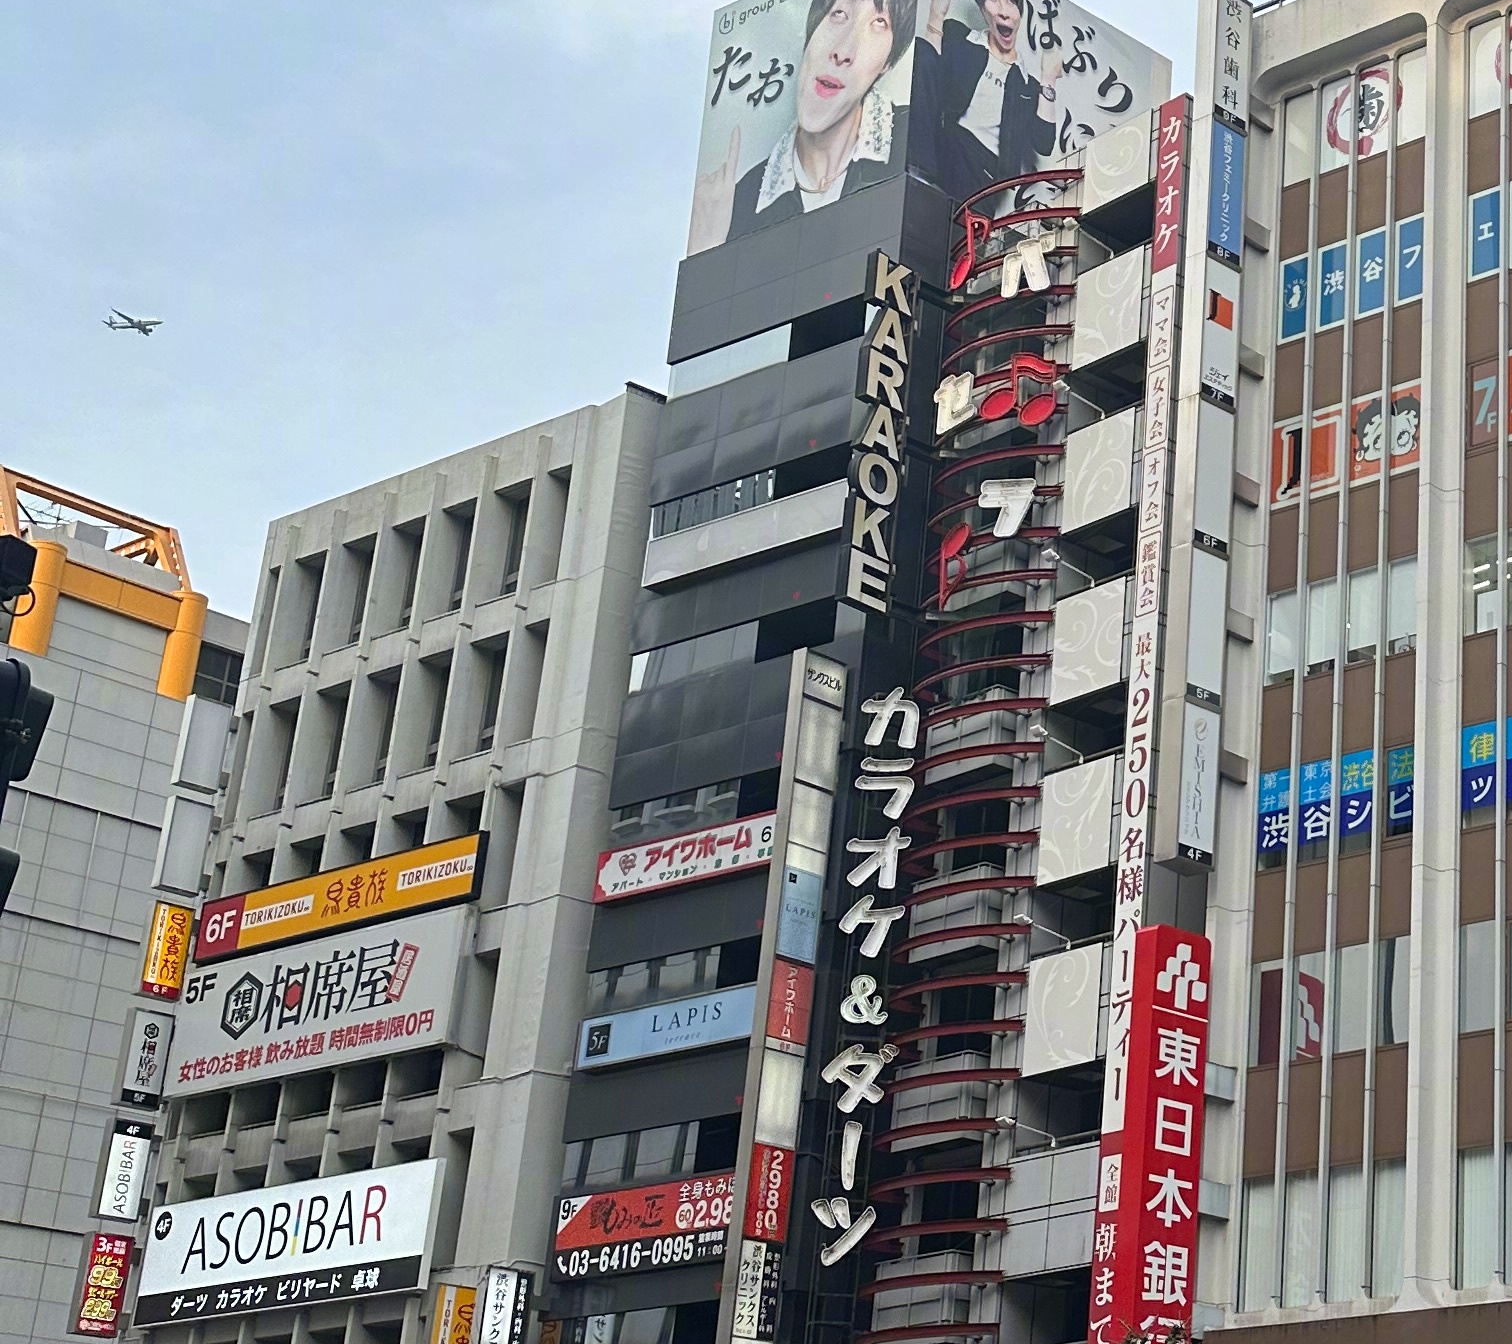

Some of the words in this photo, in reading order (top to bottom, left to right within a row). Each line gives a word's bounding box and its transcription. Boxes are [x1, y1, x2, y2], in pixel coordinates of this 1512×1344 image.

[1154, 117, 1183, 255] カラオケ
[1152, 295, 1171, 358] ママ会
[841, 250, 913, 614] KARAOKE
[1148, 375, 1167, 441] 女子会
[1144, 457, 1162, 524] オフ会
[643, 825, 753, 873] アイワホーム
[1110, 632, 1153, 1103] 最大250名様パーティー
[1187, 847, 1203, 861] 4F
[320, 867, 389, 919] 鳥貴族
[400, 864, 468, 887] TORIKIZOKU
[204, 909, 238, 944] 6F
[244, 899, 303, 926] TORIKIZOKU
[152, 985, 169, 995] 6F
[186, 972, 218, 1005] 5F
[260, 938, 400, 1034] 相席屋
[810, 685, 921, 1268] カラオケ&ダーツ
[178, 1045, 263, 1084] 女性のお客様
[265, 1032, 326, 1065] 飲み放題
[328, 1008, 435, 1051] 時間無制限0円
[588, 1030, 609, 1052] 5F
[651, 1000, 723, 1034] LAPIS
[126, 1125, 141, 1135] 4F
[115, 1139, 137, 1215] ASOBIBAR
[1102, 1162, 1121, 1206] 全館
[95, 1236, 113, 1254] 3F
[155, 1216, 172, 1237] 4F
[181, 1184, 387, 1275] ASOBIBAR
[568, 1234, 695, 1277] 03-6416-0995
[169, 1293, 209, 1318] ダーツ
[215, 1284, 268, 1311] カラオケ
[276, 1273, 342, 1301] ビリヤード
[350, 1266, 381, 1291] 卓球
